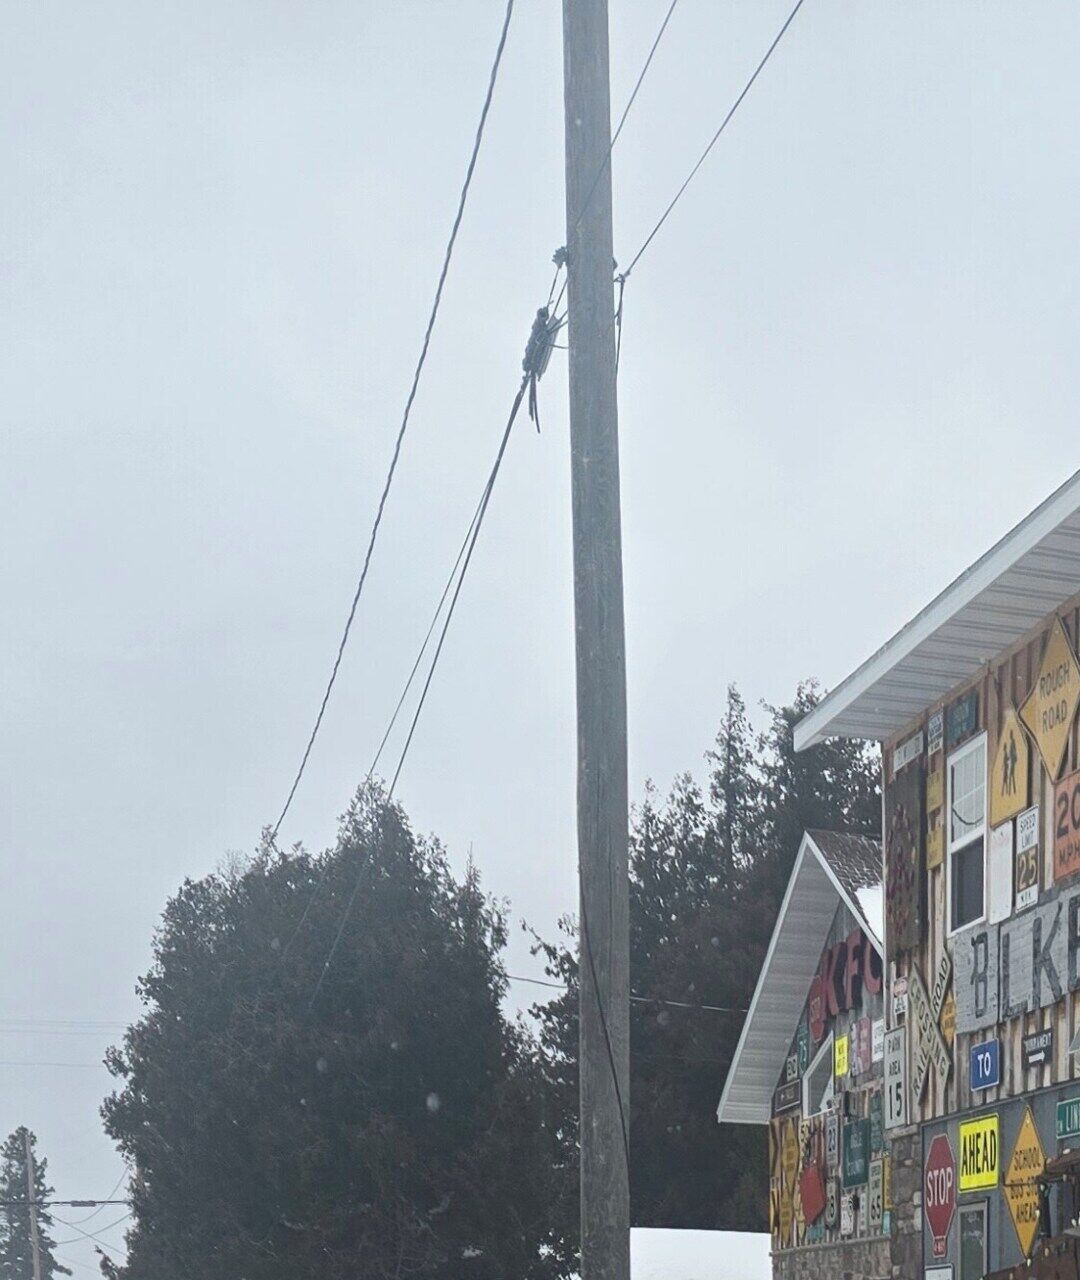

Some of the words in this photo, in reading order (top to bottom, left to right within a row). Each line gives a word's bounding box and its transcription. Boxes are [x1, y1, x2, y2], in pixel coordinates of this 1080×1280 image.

[1041, 660, 1070, 701] ROUGH
[1043, 699, 1067, 734] ROAD
[1020, 813, 1036, 834] SPEED
[1021, 831, 1035, 849] LIMIT
[1018, 847, 1037, 890] 25
[932, 956, 949, 1014] ROAD
[910, 977, 947, 1078] CROSSING
[977, 1051, 991, 1079] TO
[887, 1080, 903, 1120] 15
[961, 1129, 997, 1177] AHEAD
[1013, 1146, 1042, 1171] SCHOOL
[926, 1166, 954, 1208] STOP
